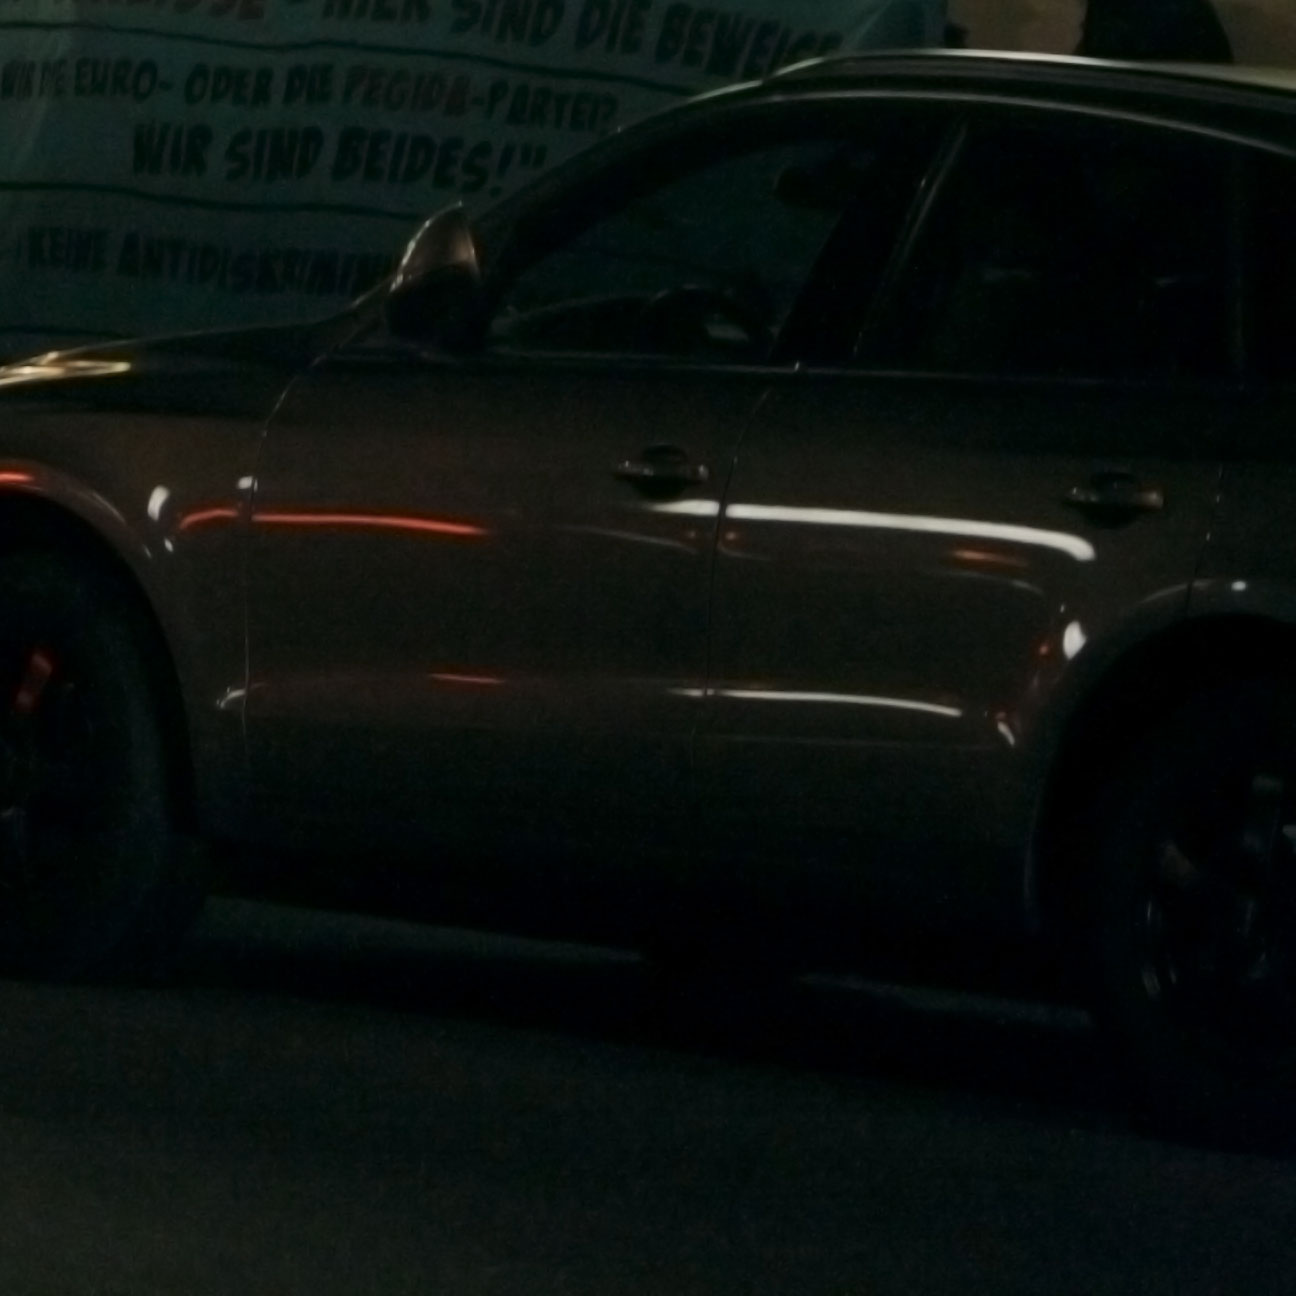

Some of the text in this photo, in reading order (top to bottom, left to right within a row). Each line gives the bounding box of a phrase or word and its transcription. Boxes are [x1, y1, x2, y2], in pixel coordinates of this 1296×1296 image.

[185, 62, 275, 106] ODER
[282, 62, 335, 105] DIE
[131, 122, 214, 177] WIR
[225, 125, 325, 182] SIND
